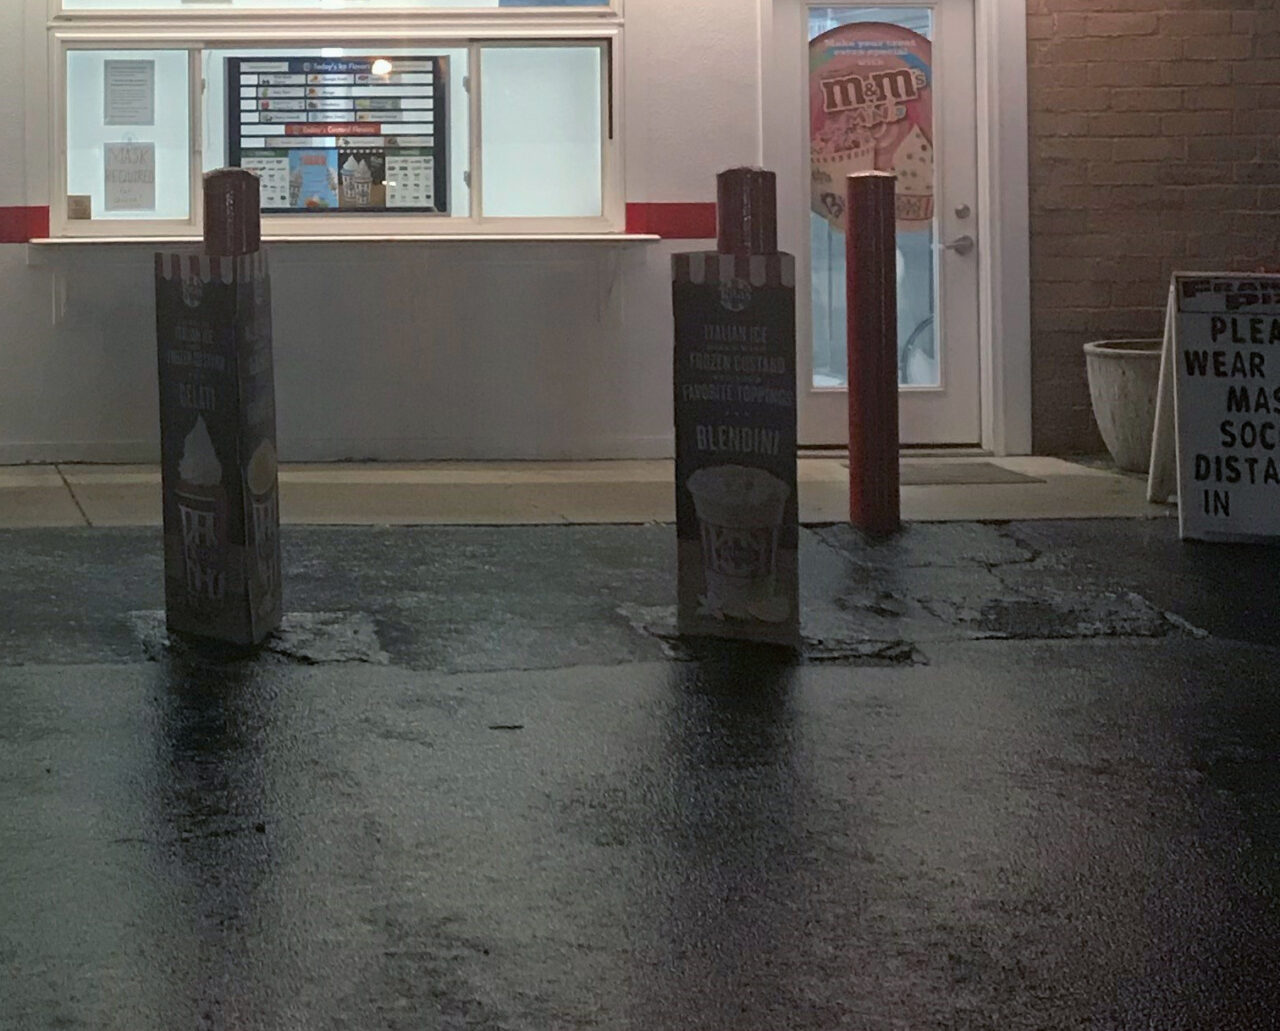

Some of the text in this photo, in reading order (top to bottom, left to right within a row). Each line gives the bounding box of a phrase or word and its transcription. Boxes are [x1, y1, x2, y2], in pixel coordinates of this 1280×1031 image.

[1184, 349, 1266, 379] WEAR
[695, 424, 781, 456] BLENDINI
[1220, 420, 1280, 450] SOC
[1194, 453, 1280, 485] DISTA
[1203, 489, 1231, 518] IN
